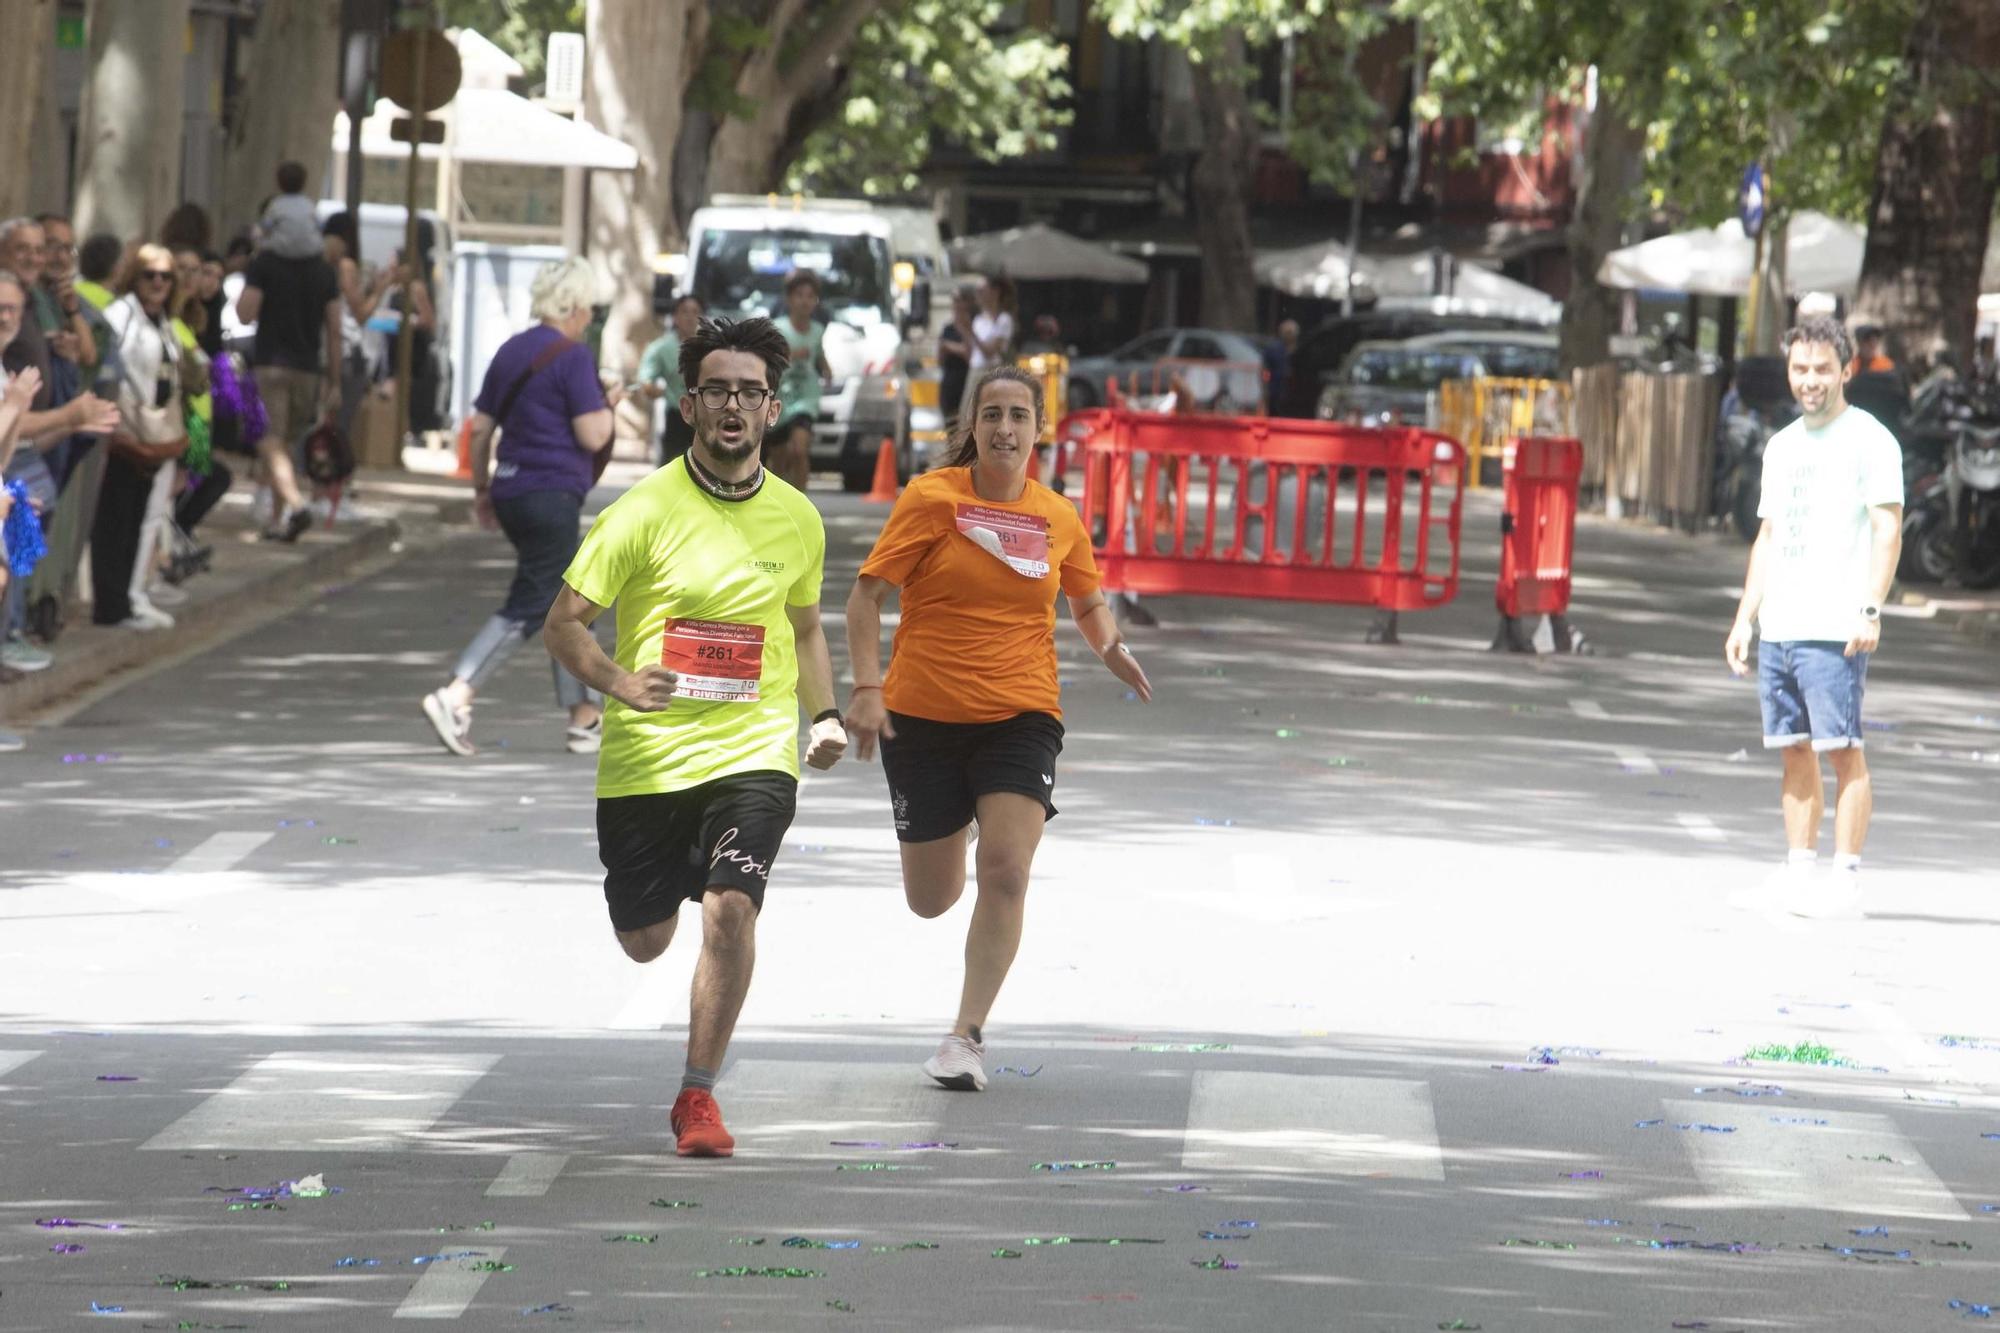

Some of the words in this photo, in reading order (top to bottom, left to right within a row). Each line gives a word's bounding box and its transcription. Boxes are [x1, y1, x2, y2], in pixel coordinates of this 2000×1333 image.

[966, 512, 985, 520] Persones
[1016, 520, 1038, 529] Funcional
[1002, 511, 1019, 519] Popular
[699, 621, 718, 629] Carrera
[717, 622, 737, 631] Popular
[675, 626, 698, 635] Persones
[709, 629, 733, 638] Diversitat
[733, 632, 757, 640] Funcional
[697, 644, 734, 660] #261
[692, 688, 750, 701] DIVERSITAT
